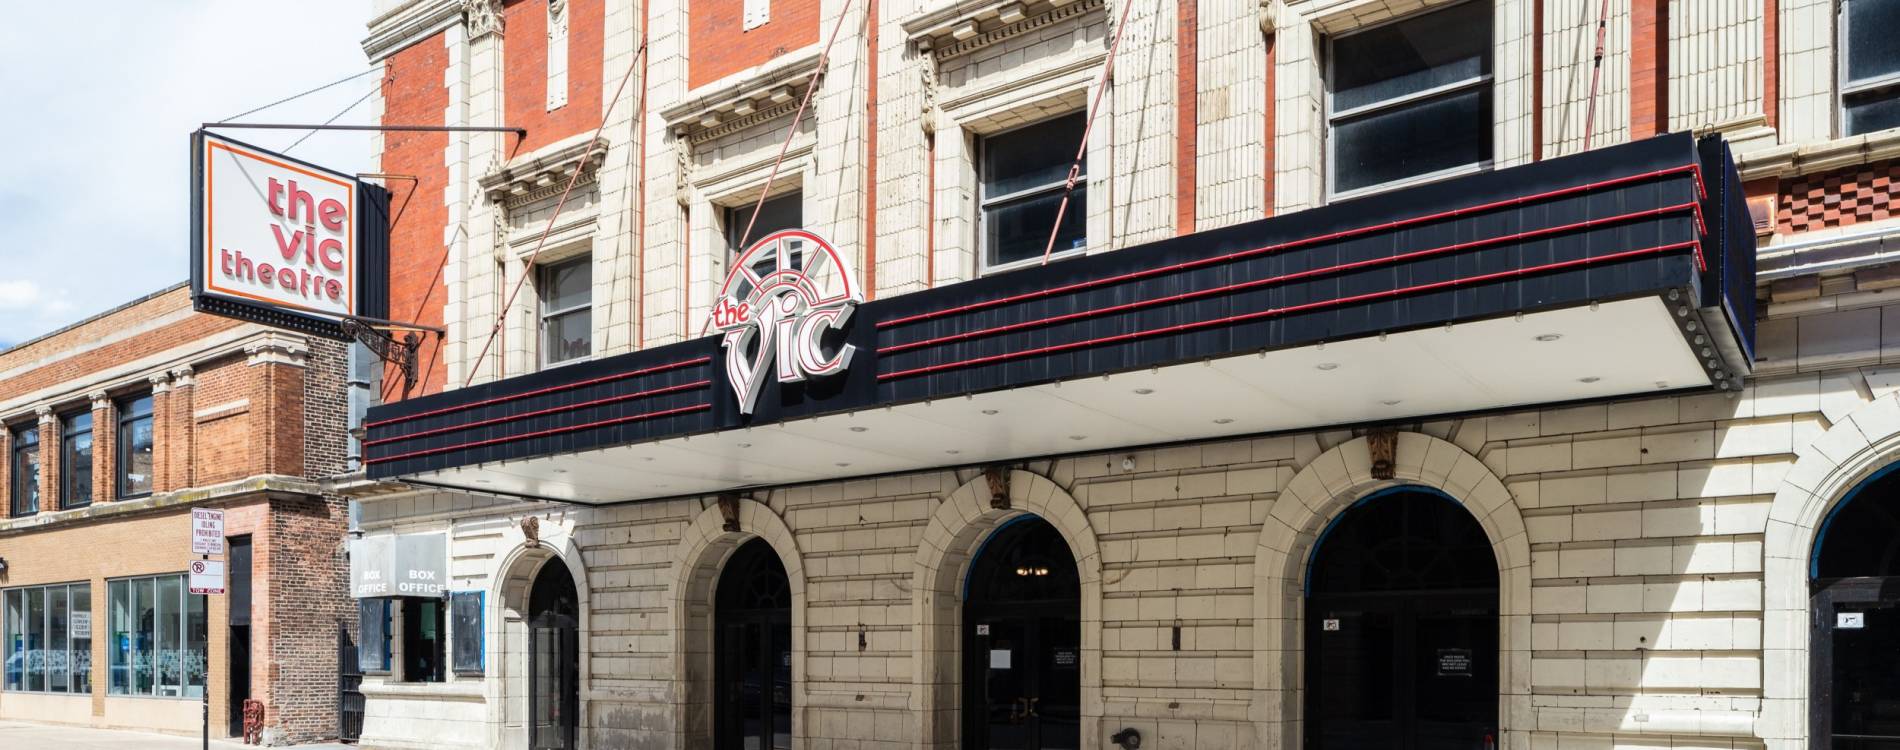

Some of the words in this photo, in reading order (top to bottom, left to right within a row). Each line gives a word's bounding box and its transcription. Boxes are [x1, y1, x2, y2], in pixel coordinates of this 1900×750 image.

[268, 177, 346, 231] the
[270, 224, 342, 271] vic
[221, 249, 342, 299] theatre
[713, 299, 749, 326] the
[722, 292, 856, 414] Vic
[358, 583, 387, 593] OFFICE
[363, 570, 380, 580] BOX
[398, 582, 445, 593] OFFICE
[408, 570, 435, 580] BOX
